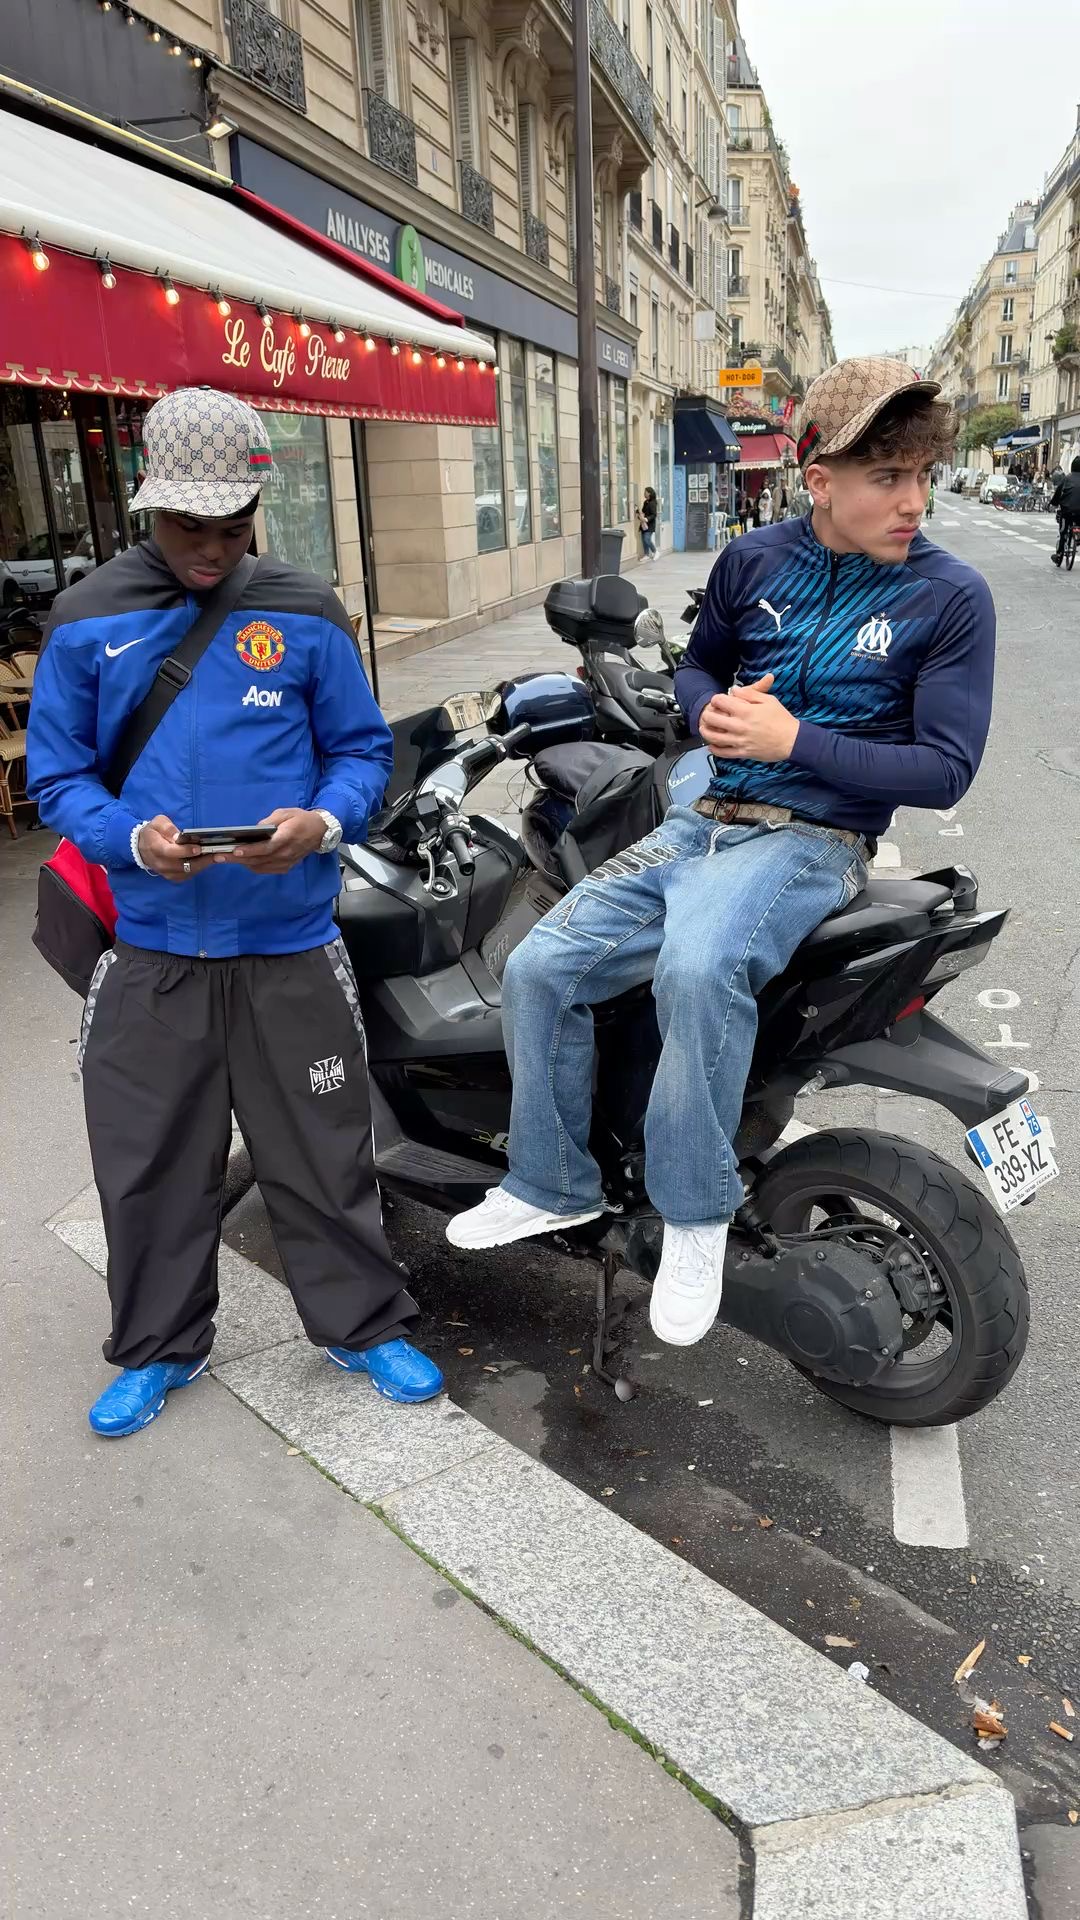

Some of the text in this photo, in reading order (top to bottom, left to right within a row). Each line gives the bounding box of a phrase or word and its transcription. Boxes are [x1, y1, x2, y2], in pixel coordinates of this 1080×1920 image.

[326, 207, 474, 300] ANALYSES MEDICALES
[221, 318, 350, 387] Le Café Pierre
[602, 342, 612, 361] LE
[726, 372, 756, 382] HOT-DOG
[240, 623, 281, 641] MANCHESTER
[248, 657, 277, 667] UNITED
[312, 1064, 342, 1084] VILLAIN
[1027, 1116, 1041, 1134] 75
[980, 1151, 987, 1162] F
[994, 1139, 1049, 1194] 339-XZ
